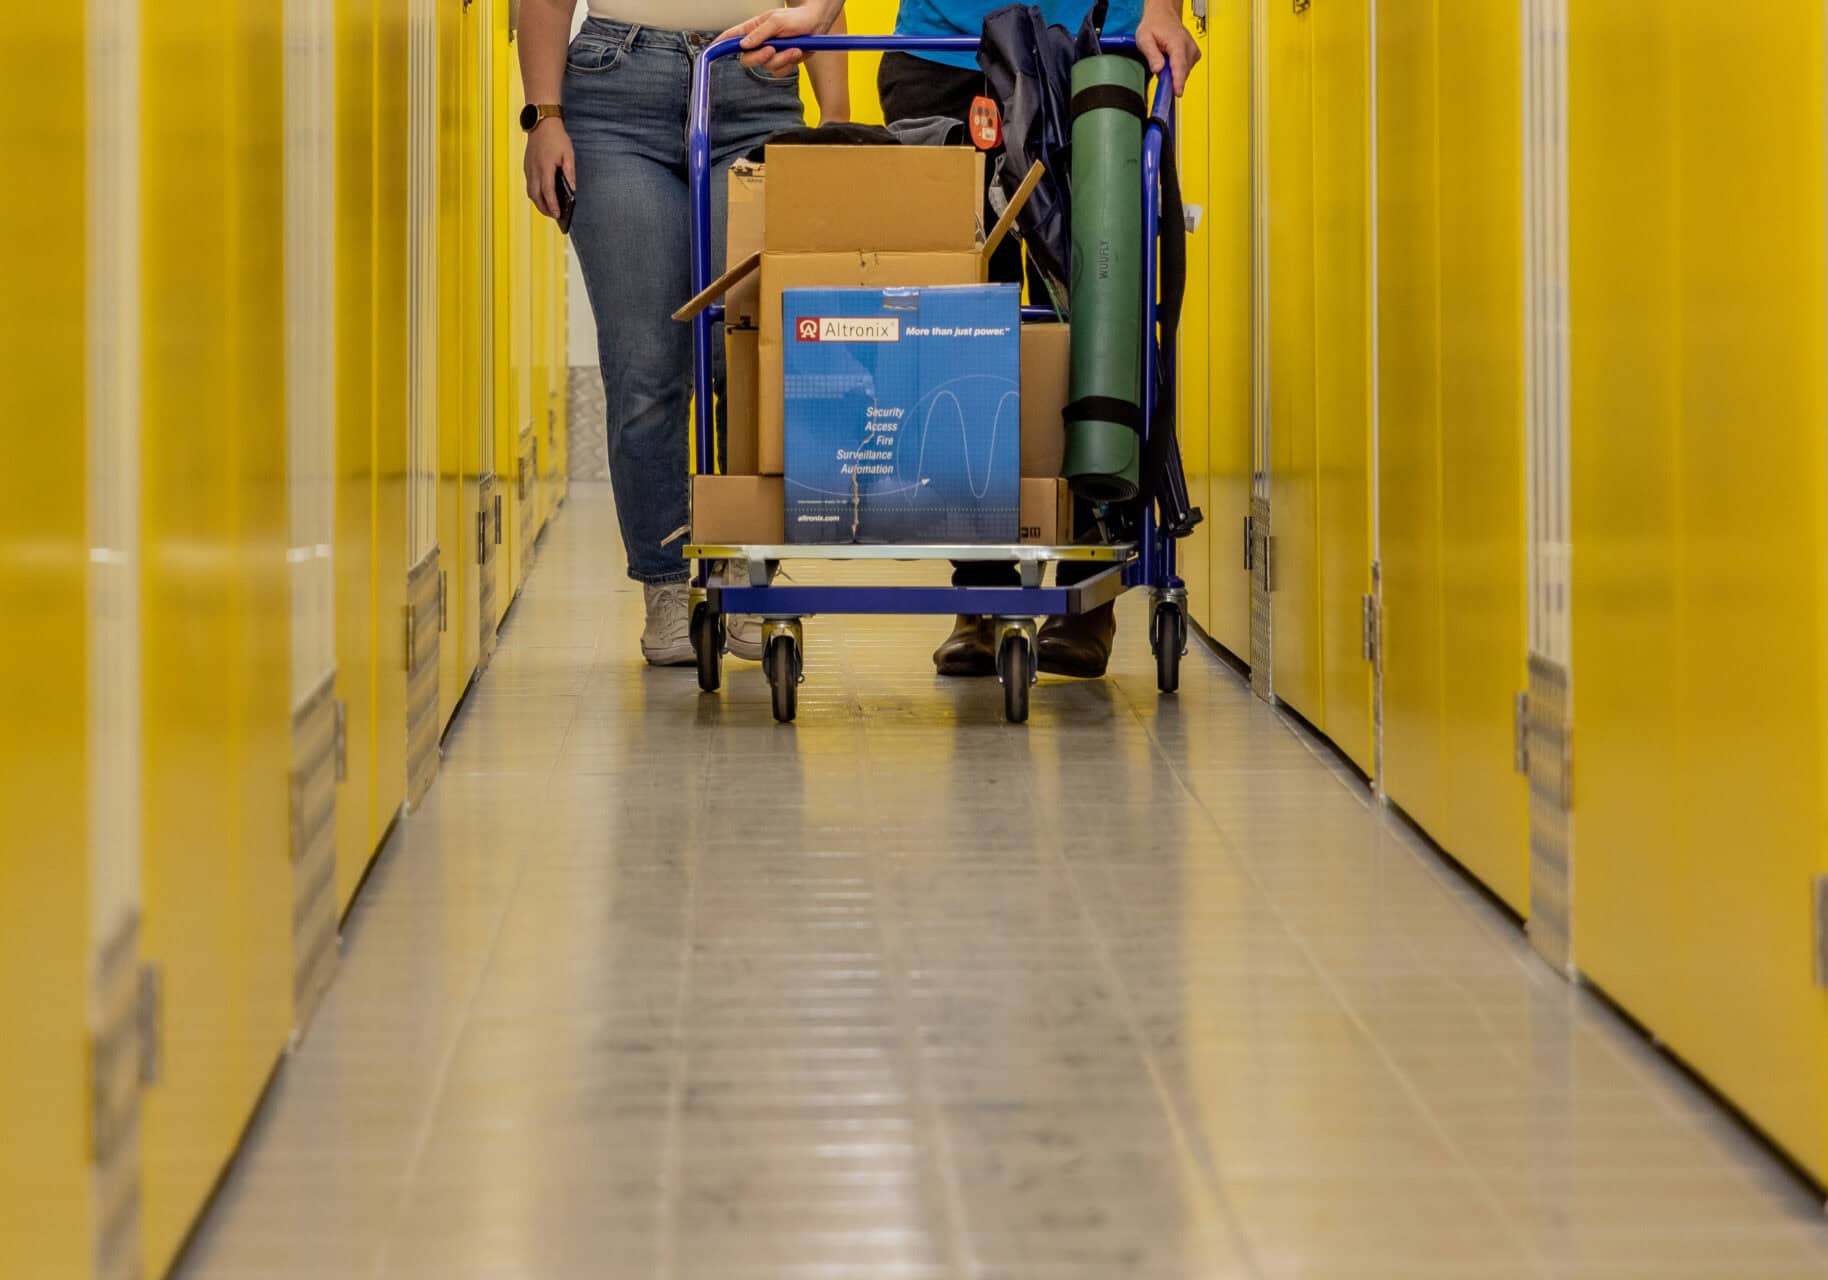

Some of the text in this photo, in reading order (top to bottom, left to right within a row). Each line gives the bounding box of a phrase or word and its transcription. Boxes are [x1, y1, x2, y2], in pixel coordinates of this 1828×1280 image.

[825, 322, 889, 337] Altronix
[905, 327, 929, 336] More
[932, 327, 953, 336] than
[954, 327, 973, 338] just
[866, 407, 904, 419] Security
[865, 422, 898, 431] Access
[876, 436, 893, 445] Fire
[836, 450, 893, 460] Surveillance
[841, 464, 894, 474] Automation
